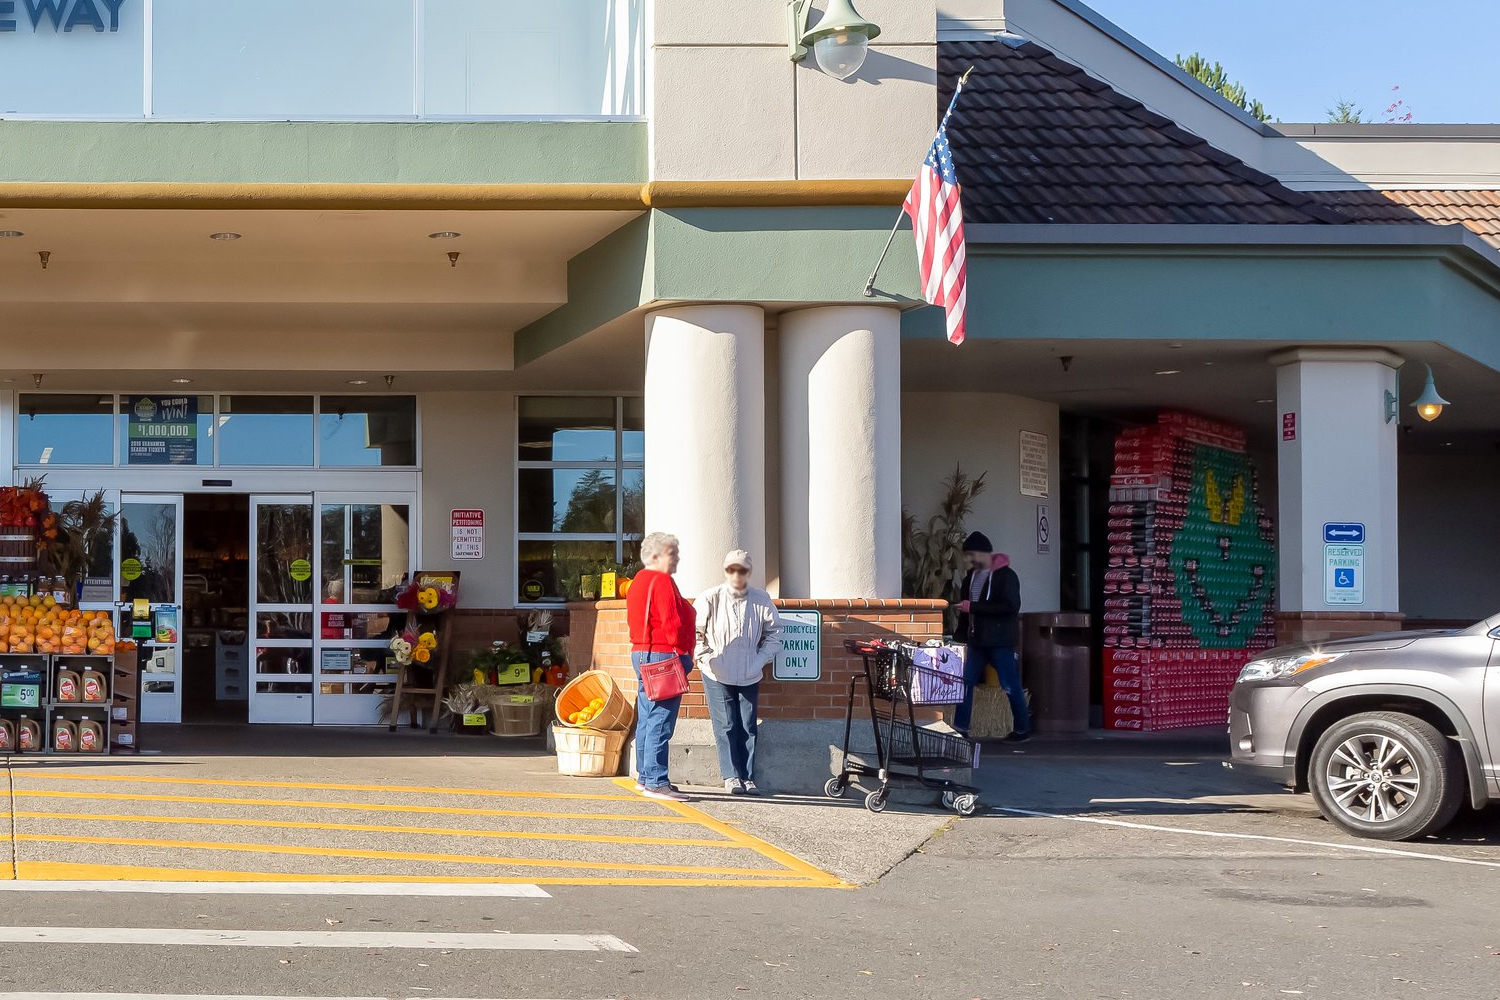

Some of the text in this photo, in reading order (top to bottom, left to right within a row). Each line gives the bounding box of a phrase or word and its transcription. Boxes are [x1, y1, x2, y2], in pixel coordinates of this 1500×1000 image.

[138, 425, 189, 437] $1,000,000
[1328, 548, 1363, 556] RESERVED
[785, 657, 808, 667] ONLY
